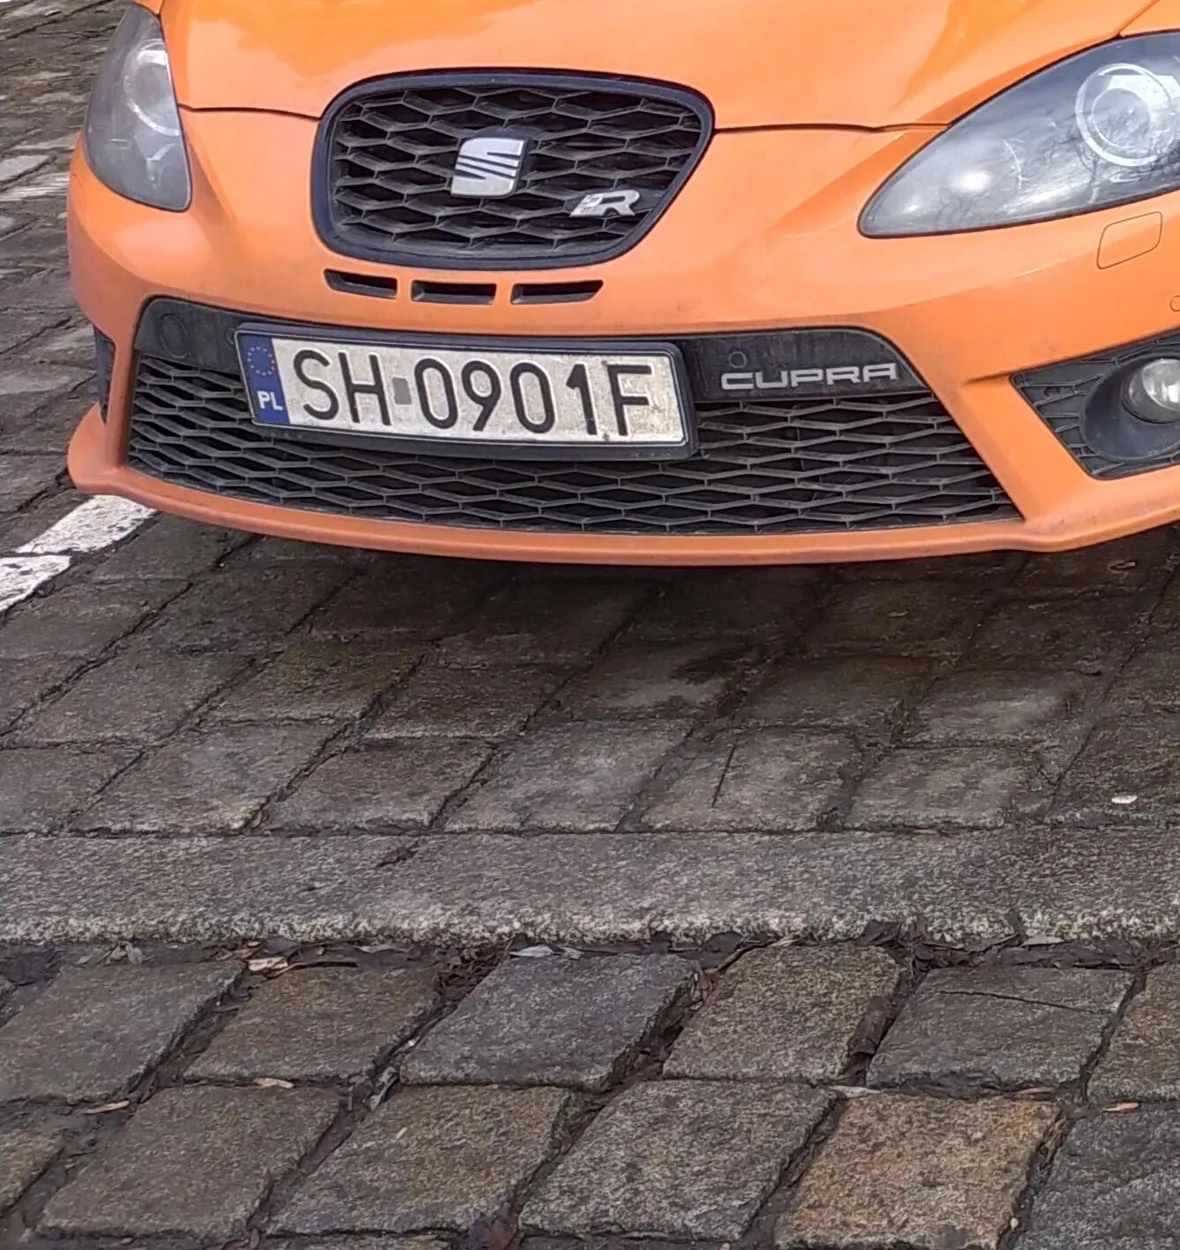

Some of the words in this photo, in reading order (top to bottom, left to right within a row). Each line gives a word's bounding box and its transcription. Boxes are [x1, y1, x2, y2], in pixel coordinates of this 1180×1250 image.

[721, 363, 897, 391] CUPRA
[258, 390, 283, 412] PL
[293, 350, 391, 426] SH
[414, 358, 652, 437] 0901F
